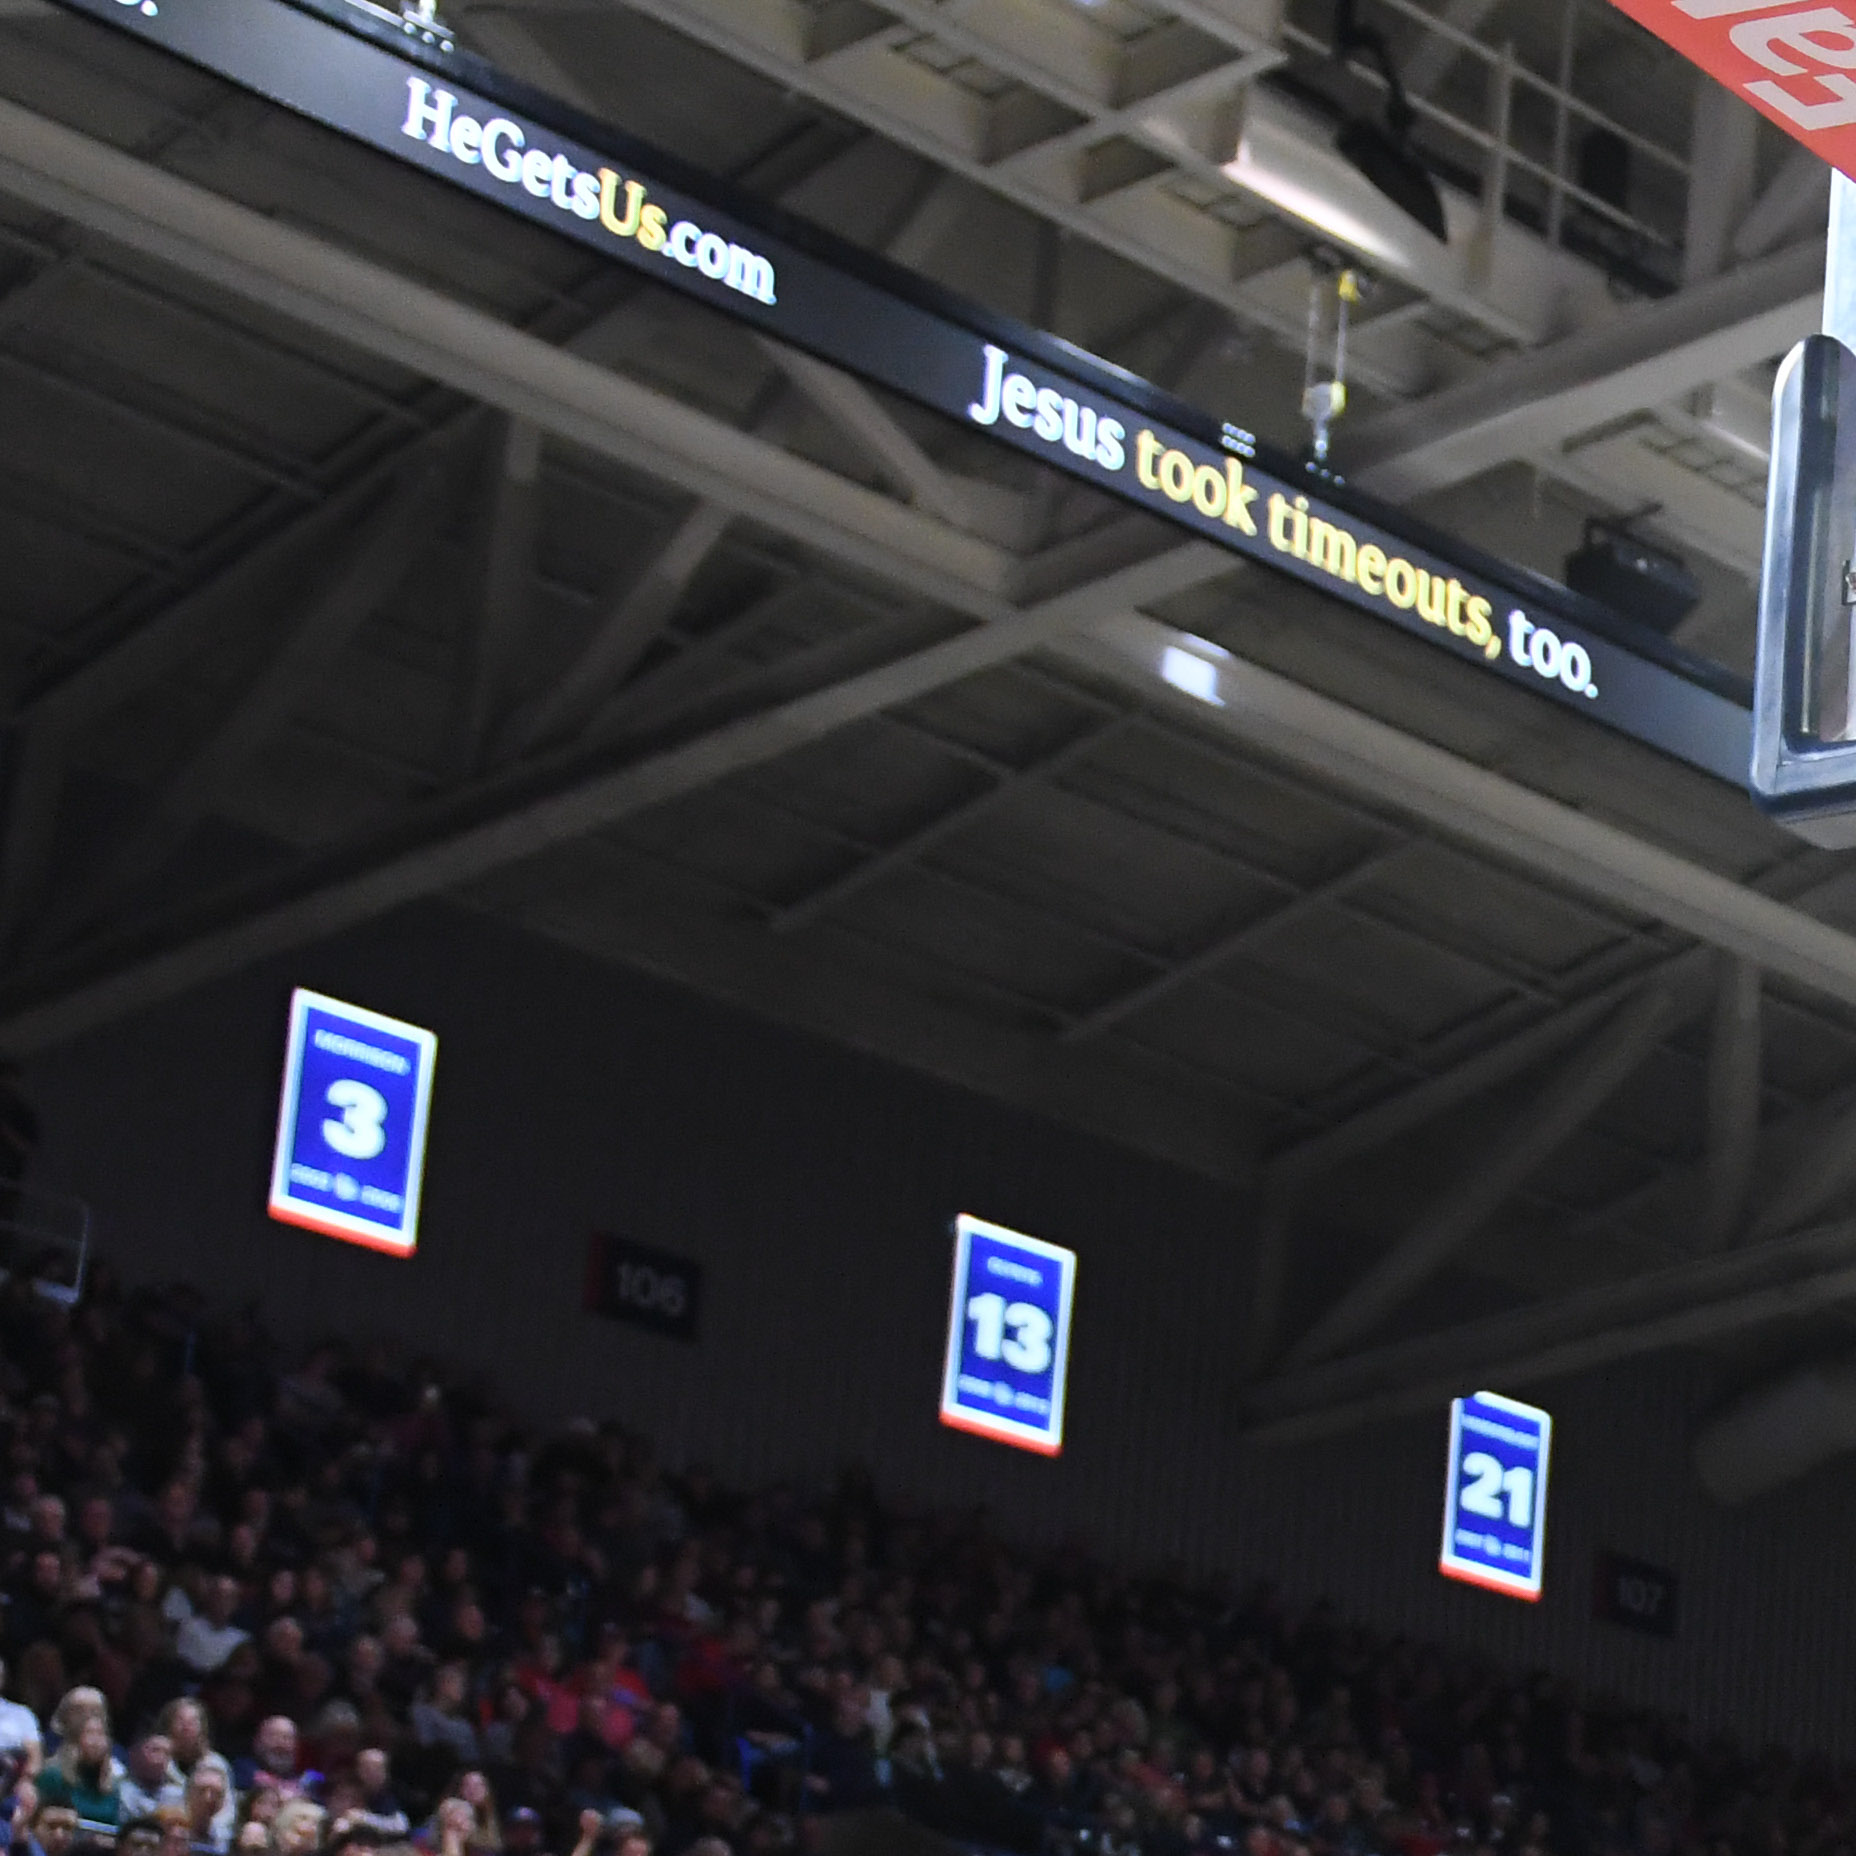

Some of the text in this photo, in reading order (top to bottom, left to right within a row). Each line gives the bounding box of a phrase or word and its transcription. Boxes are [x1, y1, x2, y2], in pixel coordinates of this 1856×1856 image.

[402, 77, 778, 306] HeGetsUs.com
[969, 344, 1600, 700] Jesus took timeouts, too.
[321, 1078, 389, 1160] 3
[965, 1291, 1055, 1375] 13
[1459, 1450, 1534, 1530] 21
